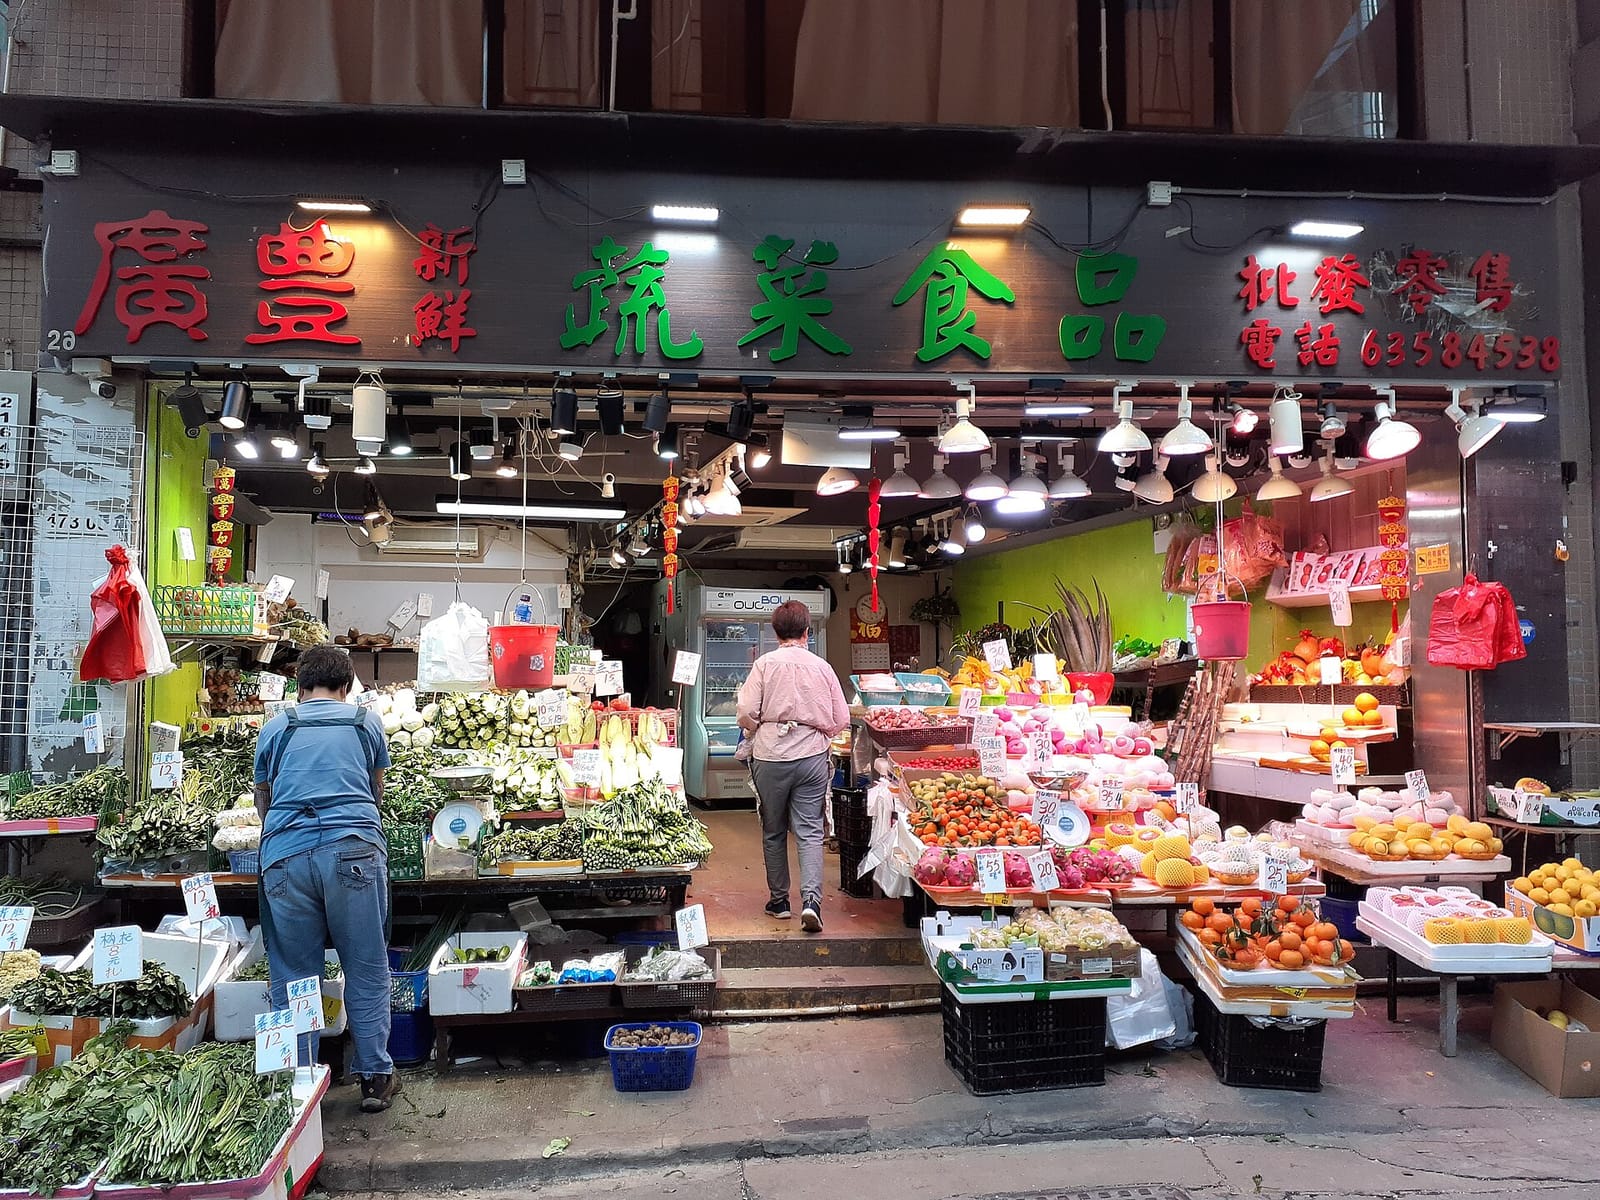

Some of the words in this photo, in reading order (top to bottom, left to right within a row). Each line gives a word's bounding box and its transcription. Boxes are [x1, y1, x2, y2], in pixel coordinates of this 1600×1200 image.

[412, 221, 478, 353] 新鮮
[1237, 250, 1515, 314] 批發零售
[560, 234, 1167, 362] 蔬菜食品
[1241, 320, 1340, 369] 電話
[1361, 328, 1560, 372] 63584538
[858, 622, 882, 639] 福
[965, 697, 977, 709] 12
[1036, 738, 1050, 750] 30
[1339, 755, 1352, 764] 40
[159, 764, 173, 776] 12
[1412, 778, 1425, 788] 35
[1185, 791, 1195, 806] 15
[1039, 801, 1056, 813] 30
[986, 863, 1000, 874] 55
[1037, 863, 1051, 879] 20
[1267, 865, 1282, 881] 25
[193, 889, 206, 905] 12
[1, 923, 15, 937] 12
[109, 946, 119, 957] 8
[107, 956, 120, 967] 元
[976, 957, 992, 965] Don
[297, 1000, 310, 1013] 12
[265, 1032, 283, 1050] 12
